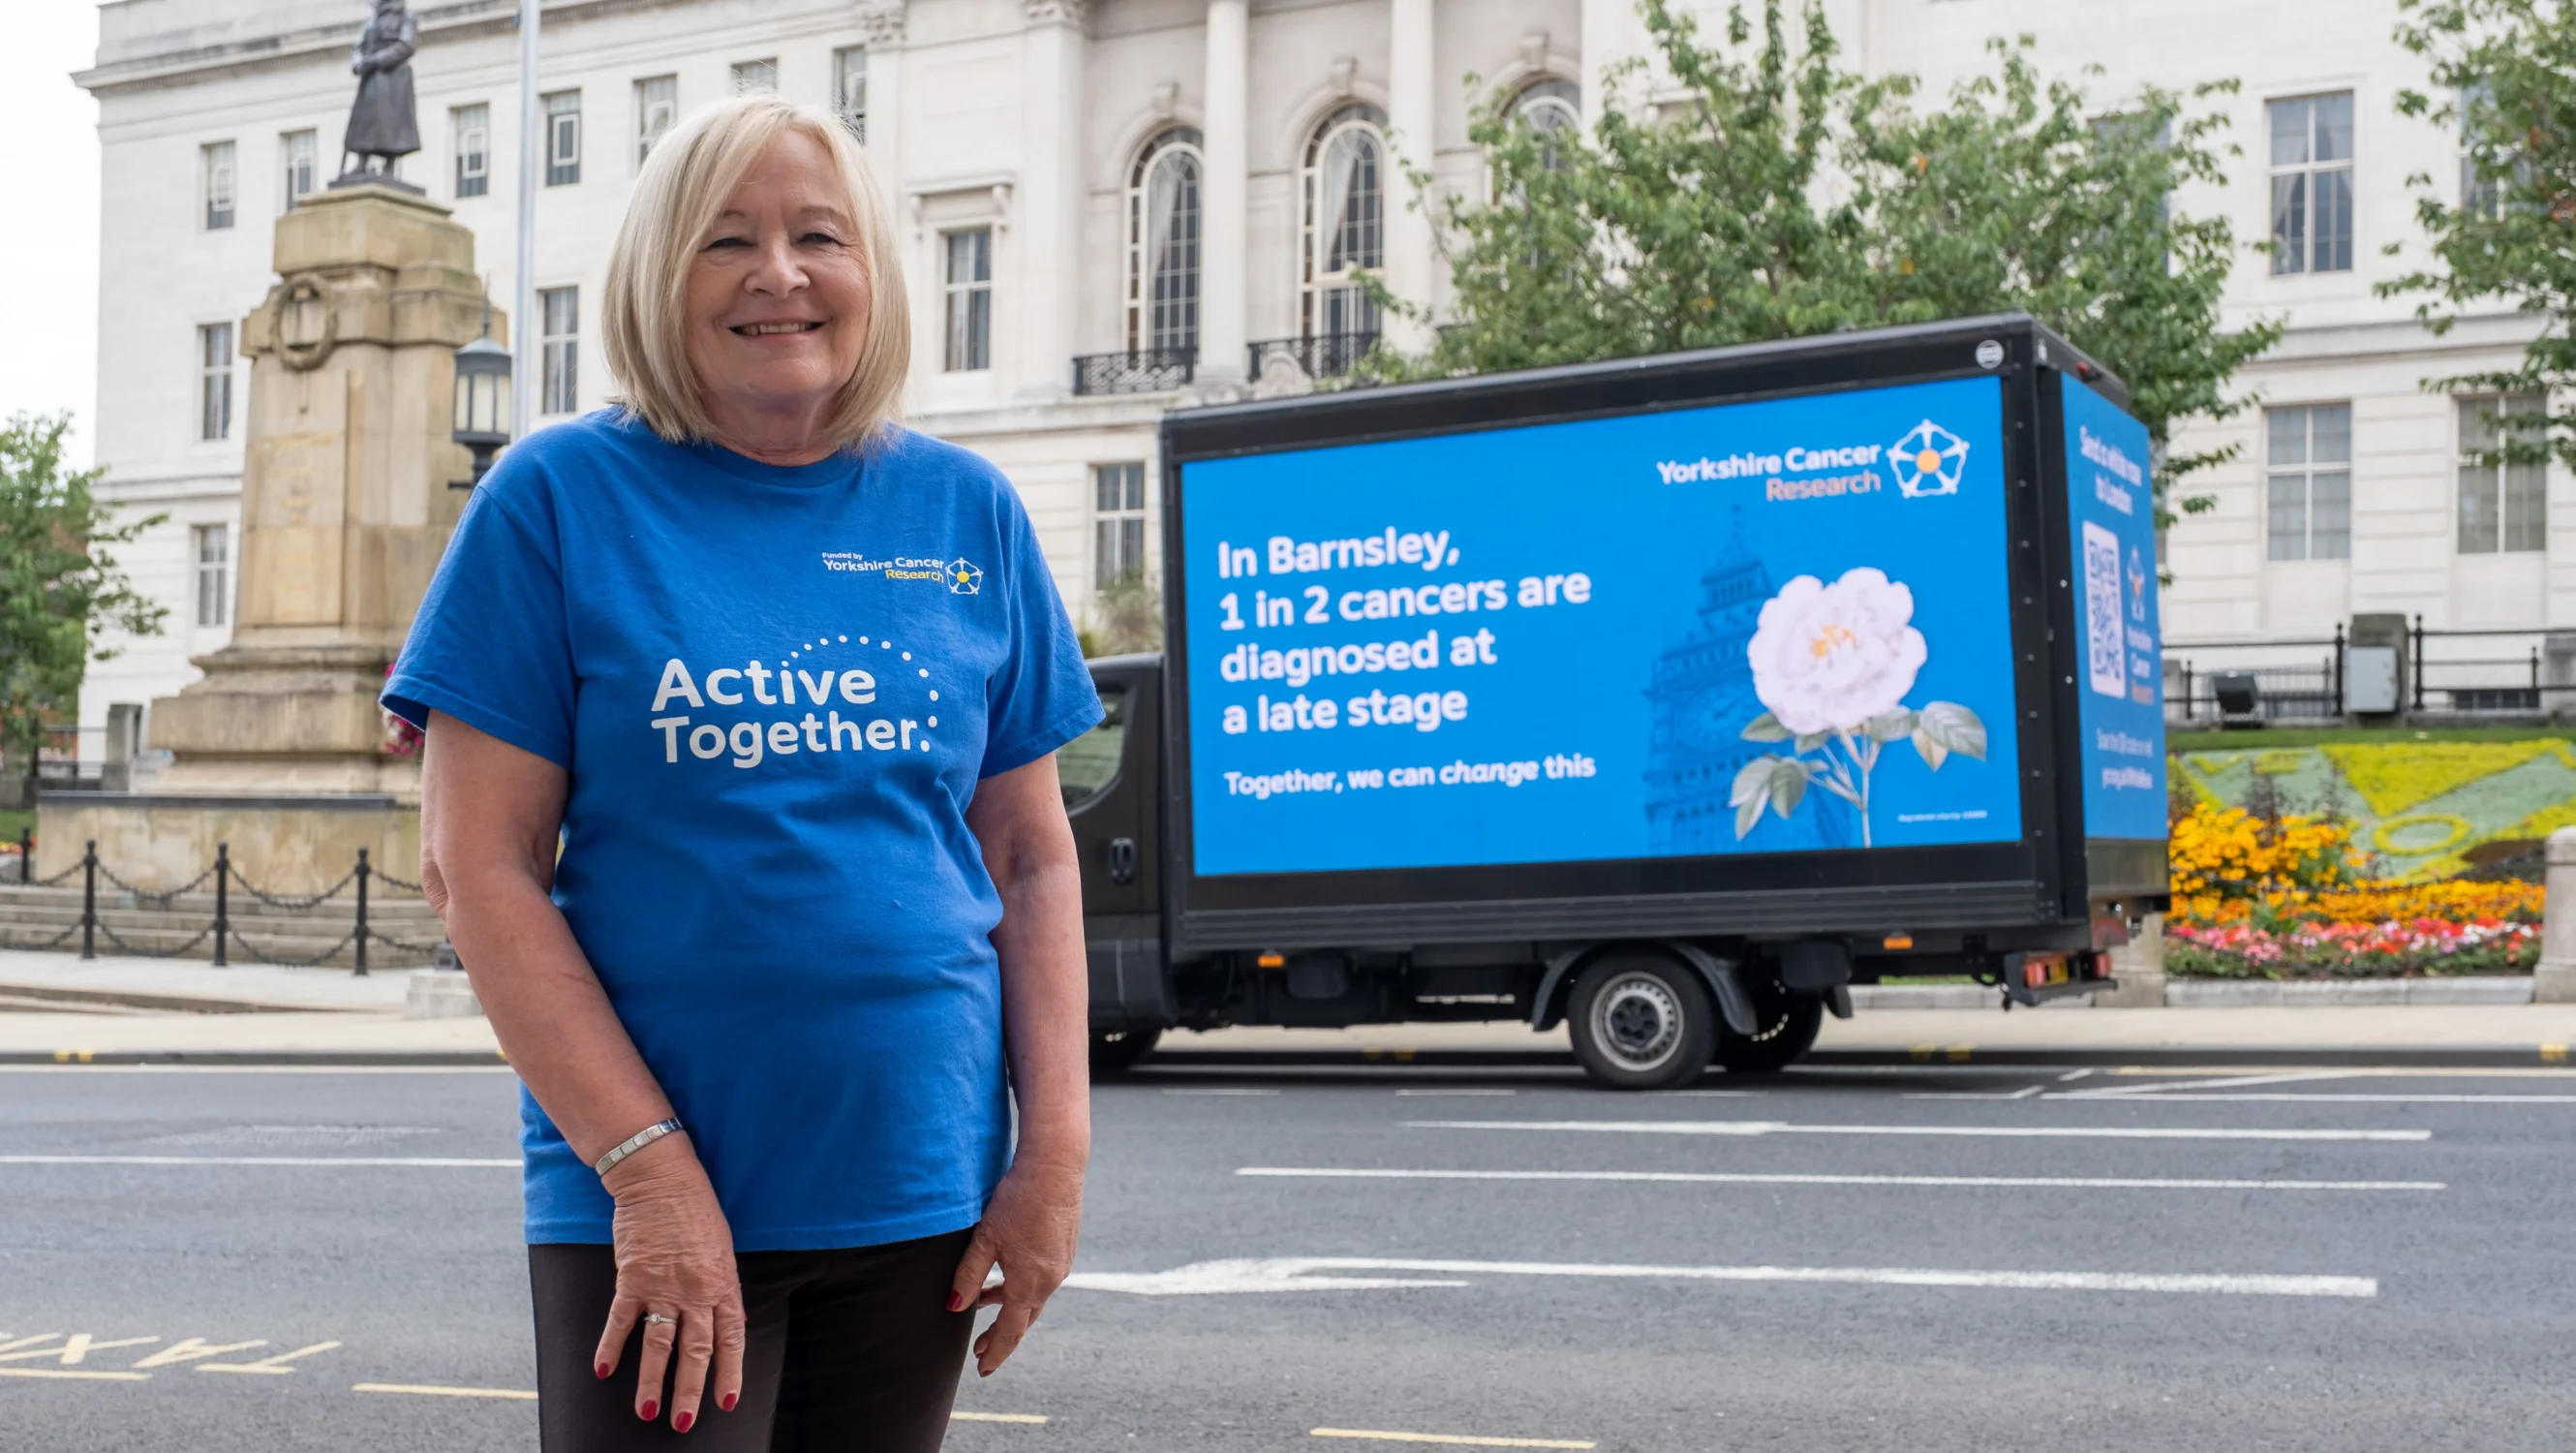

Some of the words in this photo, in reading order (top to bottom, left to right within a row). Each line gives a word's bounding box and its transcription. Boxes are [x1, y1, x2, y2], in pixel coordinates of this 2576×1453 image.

[1656, 451, 1782, 484] Yorkshire
[1784, 444, 1882, 472] Cancer
[1765, 469, 1882, 502] Research
[823, 559, 893, 572] Yorkshire
[894, 557, 945, 570] Cancer
[852, 552, 864, 561] by
[1217, 541, 1258, 579] In
[1268, 525, 1460, 572] Barnsley,
[885, 569, 944, 583] Research
[1219, 592, 1245, 631] 1
[1255, 590, 1295, 628] in
[1303, 585, 1330, 624] 2
[1338, 579, 1508, 622] cancers
[1517, 572, 1592, 608] are
[1220, 629, 1440, 687] diagnosed
[1449, 627, 1498, 666] at
[651, 658, 876, 712] Active
[1222, 704, 1248, 735] a
[1257, 694, 1338, 732] late
[1347, 688, 1468, 732] stage
[1223, 768, 1343, 800] Together,
[1347, 768, 1385, 789] we
[1387, 766, 1436, 788] can
[1438, 759, 1540, 788] change
[1543, 753, 1597, 779] this
